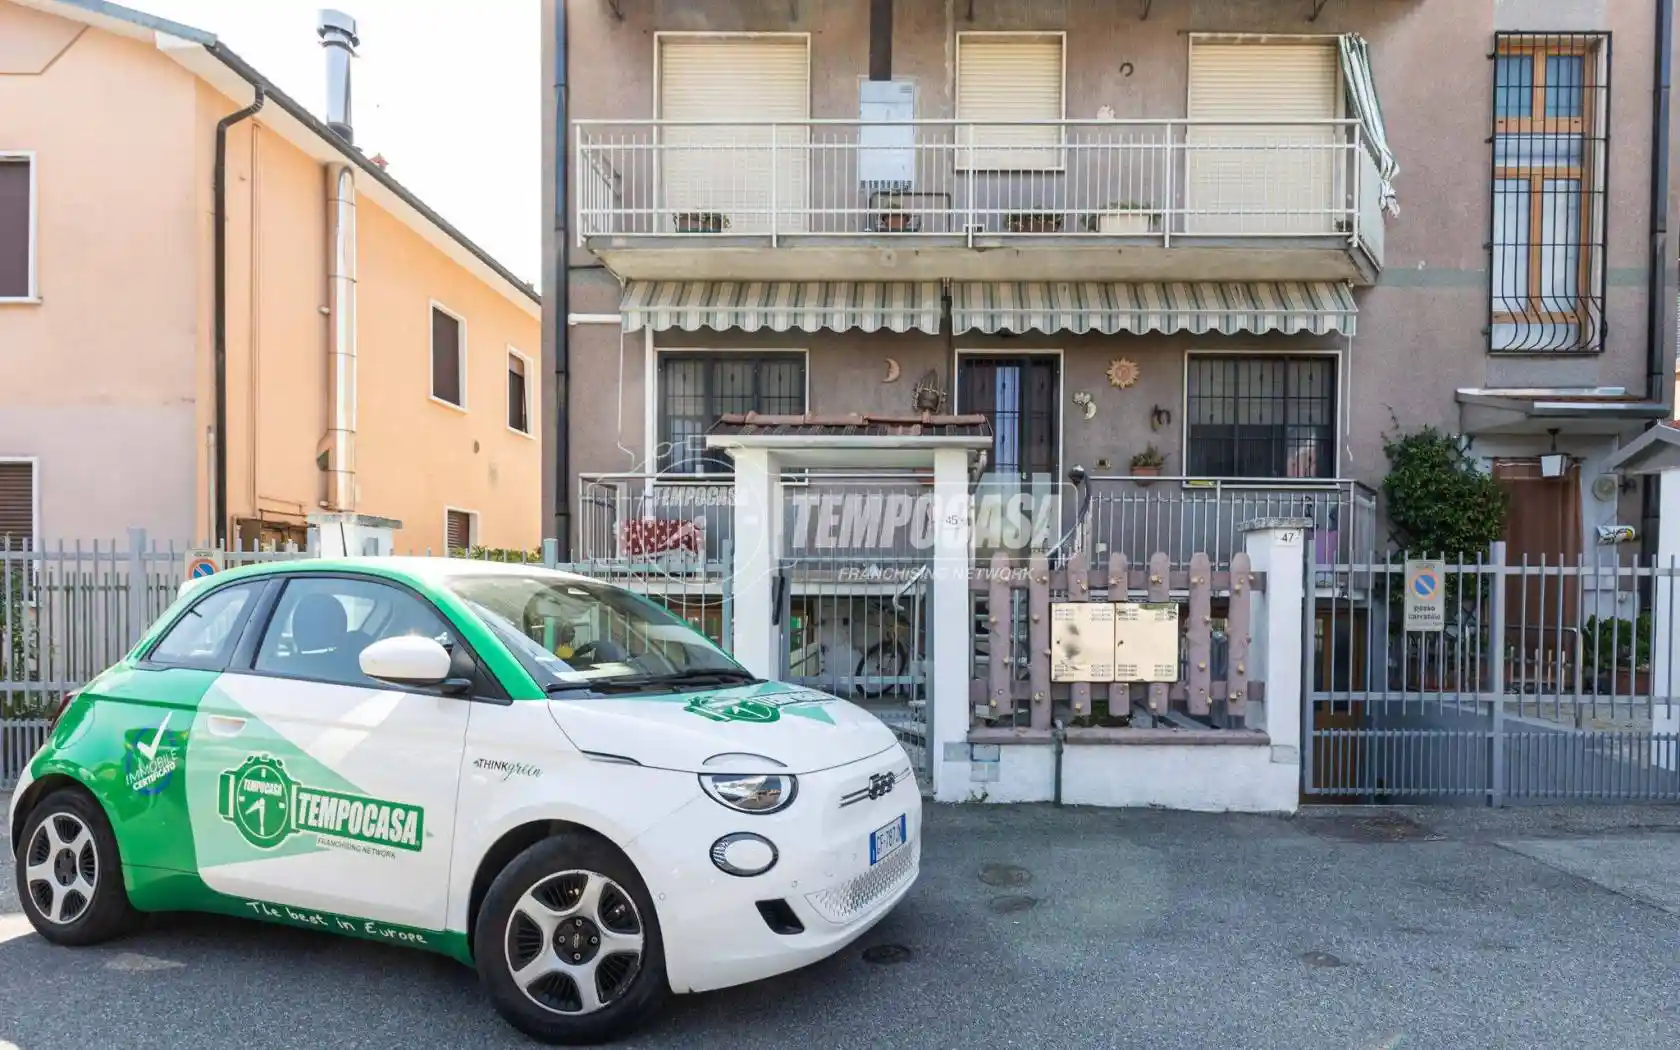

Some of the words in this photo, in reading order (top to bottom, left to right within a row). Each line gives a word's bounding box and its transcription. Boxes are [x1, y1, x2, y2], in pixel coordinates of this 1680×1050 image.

[1281, 532, 1294, 543] 47
[125, 747, 177, 786] IMMOBILE
[132, 761, 176, 791] CERTIFICATO
[244, 779, 283, 796] TEMPOCASA
[298, 792, 419, 845] TEMPOCASA
[362, 846, 396, 860] NETWORK
[246, 901, 283, 918] The
[285, 907, 329, 926] best
[336, 917, 356, 932] in
[364, 921, 428, 945] Europe
